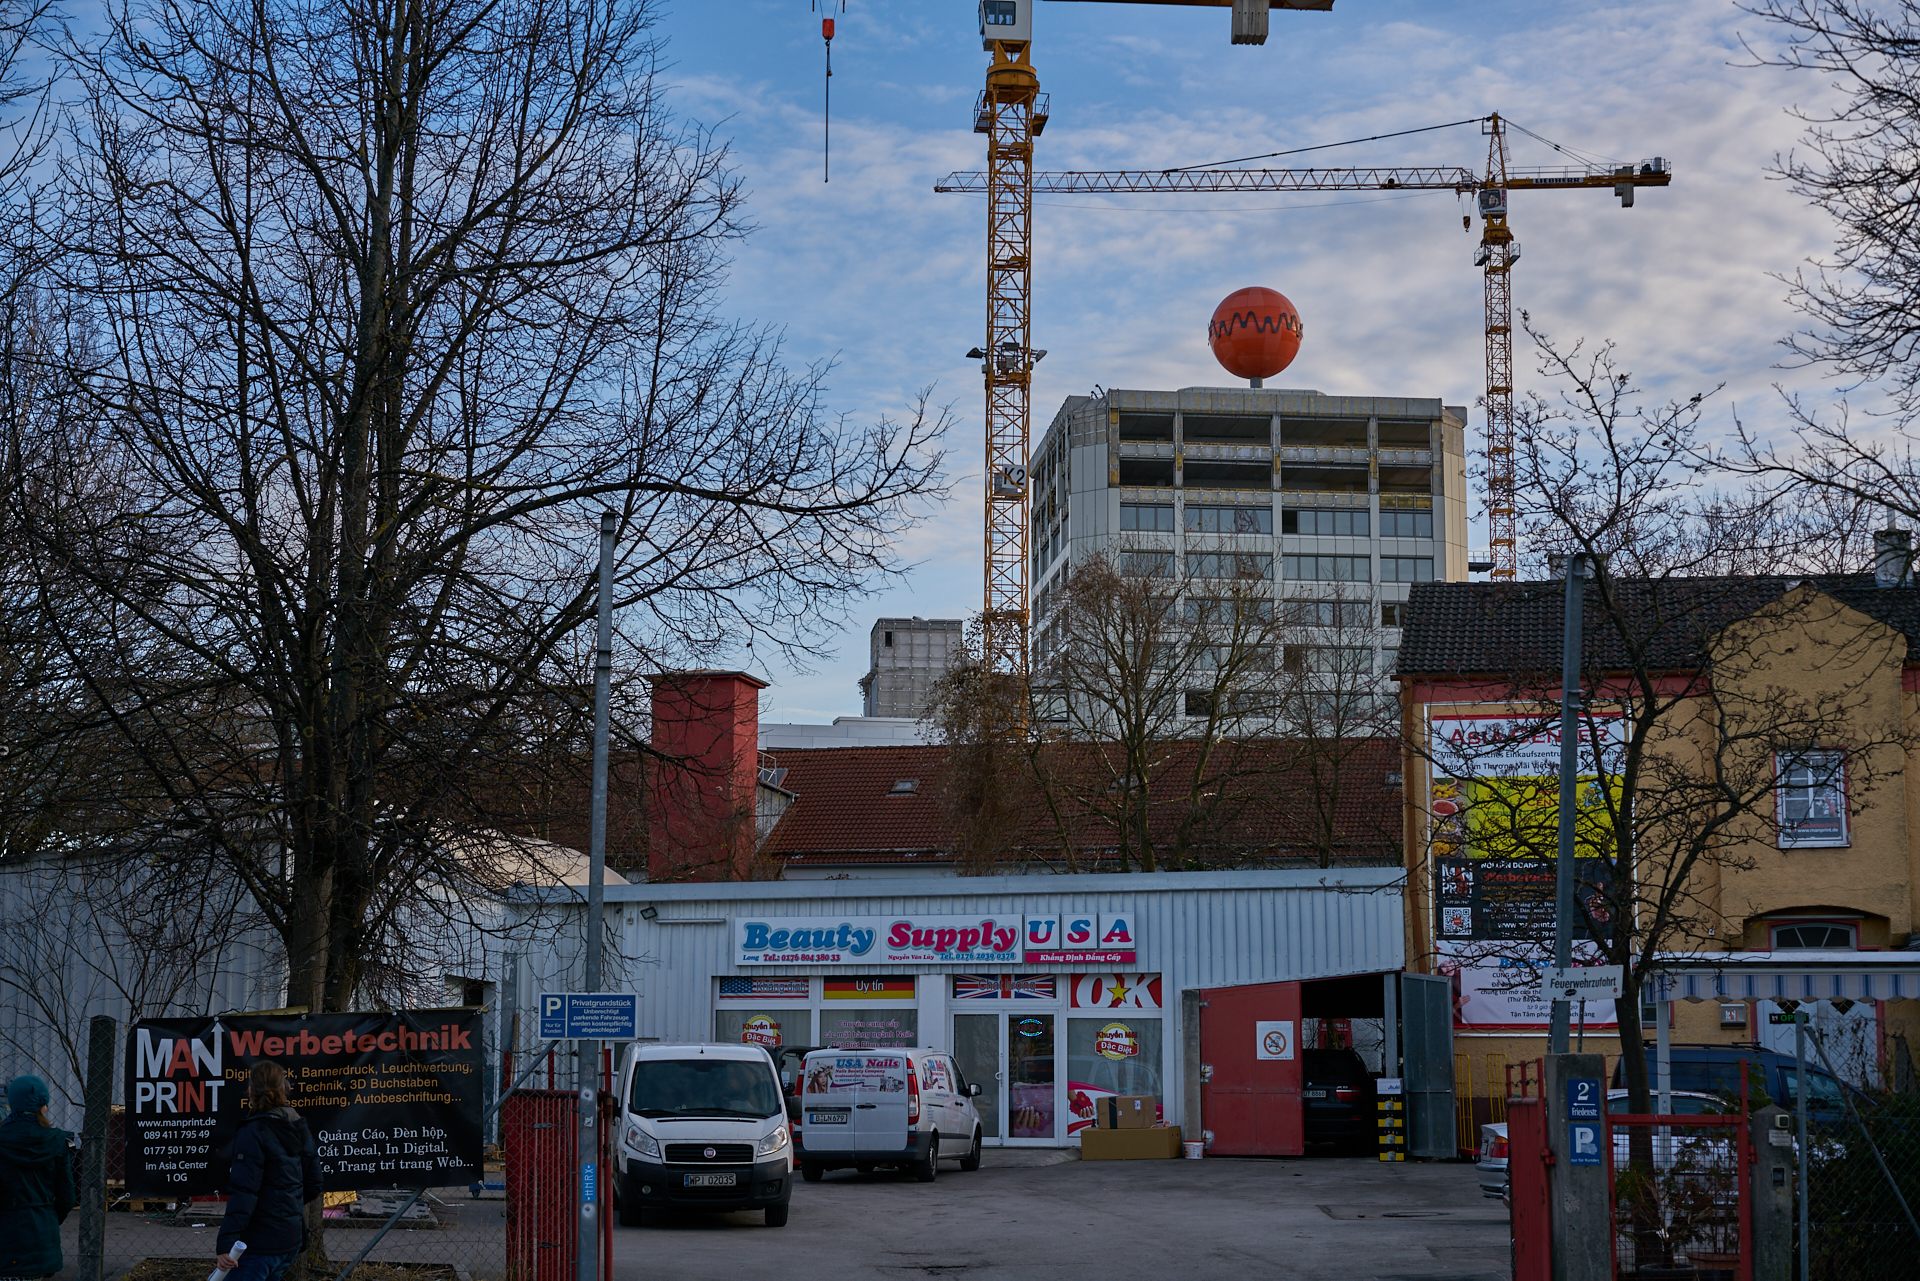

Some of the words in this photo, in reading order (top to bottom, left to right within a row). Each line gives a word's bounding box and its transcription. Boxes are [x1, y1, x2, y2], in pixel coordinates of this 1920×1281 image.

[1004, 467, 1025, 486] K2
[742, 924, 874, 954] Beauty
[887, 921, 1017, 953] Supply
[742, 954, 760, 962] Long
[781, 954, 800, 962] 0176
[800, 954, 815, 962] 804
[815, 954, 830, 962] 380
[830, 954, 841, 962] 33
[940, 952, 954, 960] Tel.
[956, 952, 974, 961] 0176
[976, 952, 994, 961] 2039
[996, 952, 1016, 961] 0378
[856, 980, 869, 994] Uy
[1550, 976, 1617, 989] Feuerwehrzufahrt
[1076, 974, 1161, 1008] OK
[546, 997, 562, 1017] P
[230, 1024, 472, 1057] Werbetechnik
[136, 1022, 225, 1079] MAN
[302, 1064, 378, 1078] Bannerdruck,
[382, 1062, 473, 1075] Leuchtwerbung,
[836, 1059, 863, 1069] USA
[866, 1058, 900, 1069] Nails
[298, 1080, 347, 1093] Technik,
[350, 1078, 367, 1090] 3D
[370, 1077, 438, 1089] Buchstaben
[1577, 1082, 1590, 1101] 2
[136, 1080, 226, 1114] PRINT
[138, 1117, 217, 1129] www.manprint.de
[144, 1131, 161, 1140] 089
[162, 1131, 178, 1140] 411
[181, 1130, 197, 1140] 795
[198, 1130, 210, 1139] 49
[318, 1129, 359, 1144] Quảng
[362, 1128, 389, 1141] Cáo,
[393, 1127, 418, 1139] Đèn
[422, 1126, 448, 1140] hộp,
[1575, 1127, 1594, 1154] P
[144, 1146, 165, 1155] 0177
[167, 1146, 183, 1155] 501
[185, 1146, 197, 1155] 79
[198, 1146, 210, 1154] 67
[343, 1143, 382, 1157] Decal,
[386, 1143, 399, 1155] In
[403, 1141, 449, 1155] Digital,
[146, 1162, 157, 1171] im
[159, 1162, 177, 1171] Asia
[179, 1161, 209, 1170] Center
[338, 1161, 376, 1173] Trang
[380, 1158, 396, 1170] trí
[399, 1159, 433, 1171] trang
[166, 1174, 171, 1182] 1
[173, 1174, 188, 1182] OG
[708, 1176, 734, 1185] 02035
